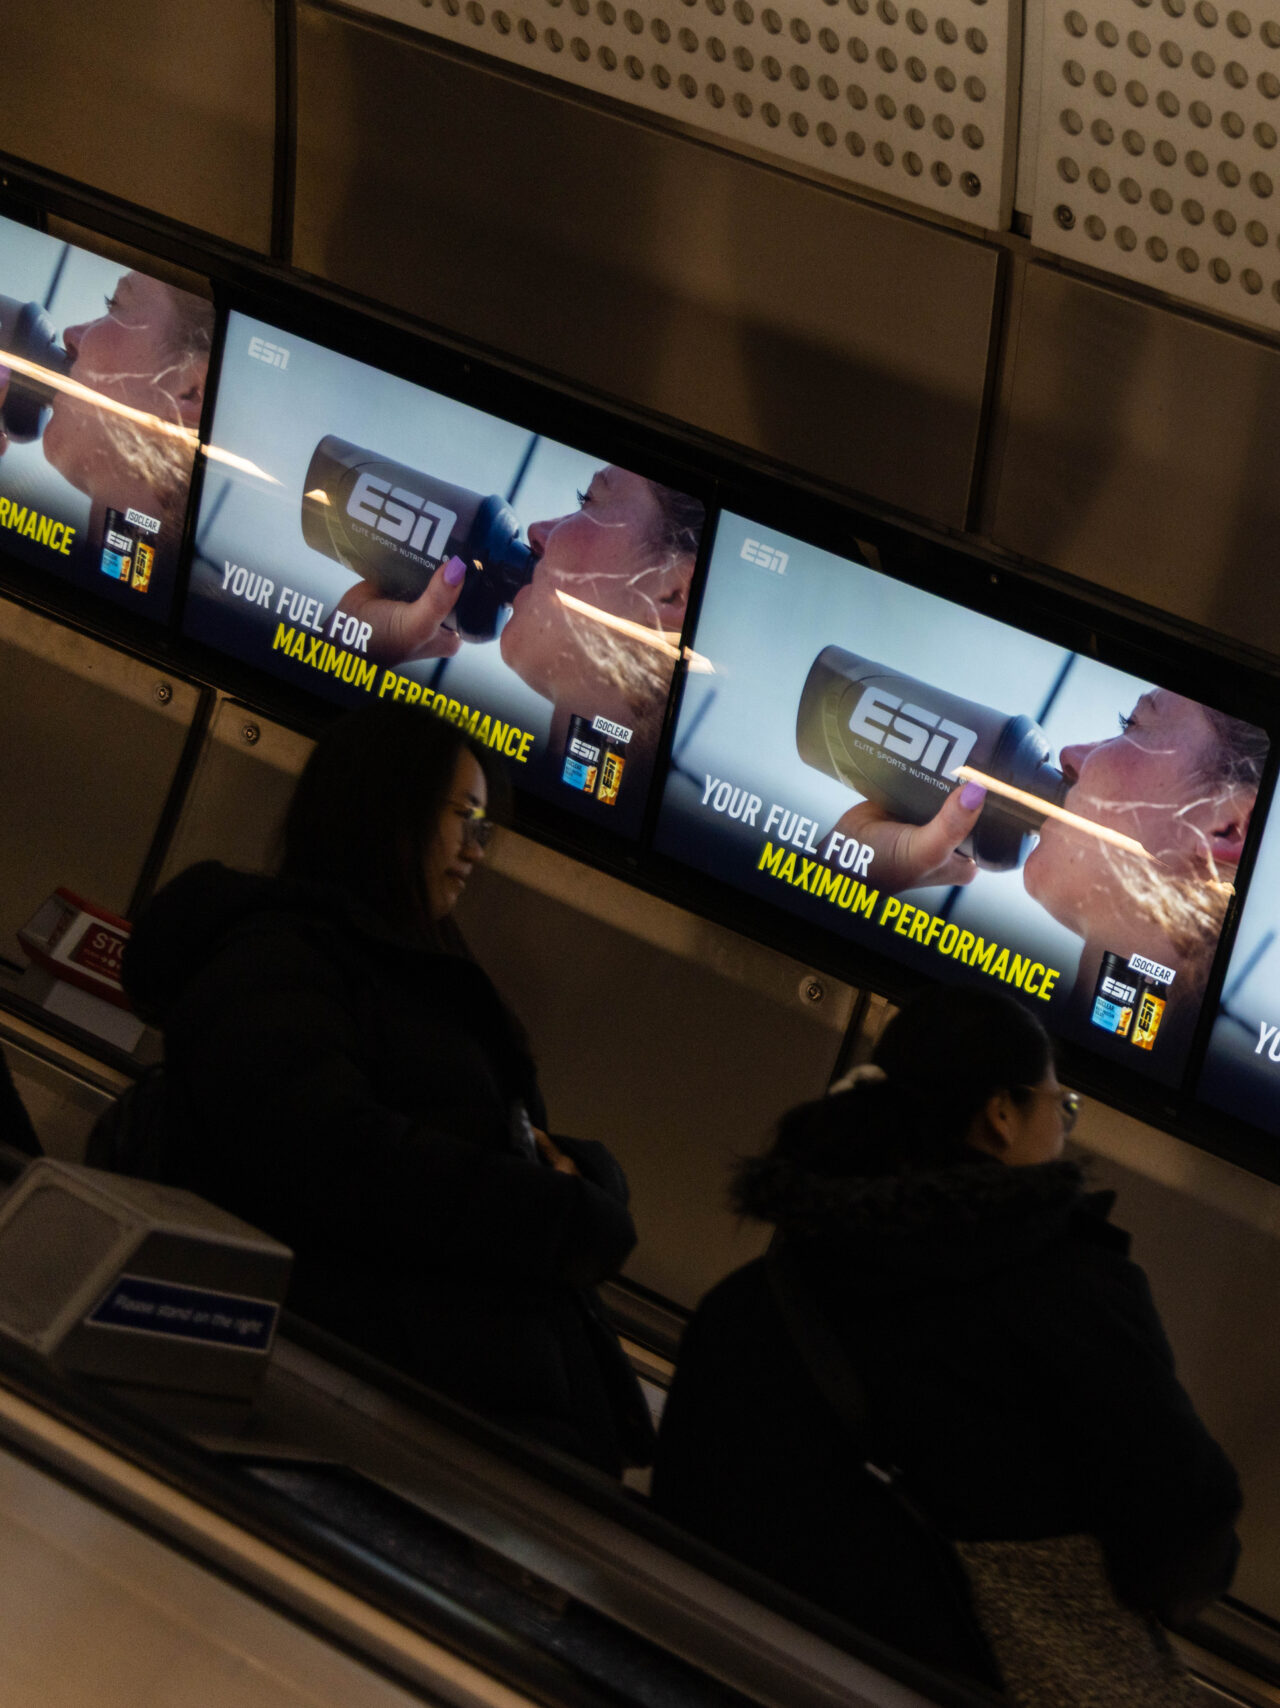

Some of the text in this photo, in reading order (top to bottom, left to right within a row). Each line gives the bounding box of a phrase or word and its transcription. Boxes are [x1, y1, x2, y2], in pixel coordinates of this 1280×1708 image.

[0, 497, 76, 556] RMANCE
[128, 510, 158, 531] ISOCLEAR
[351, 522, 436, 571] ELITE SPORTS NUTRITION
[221, 560, 373, 653] YOUR FUEL FOR
[272, 622, 378, 692] MAXIMUM
[595, 718, 629, 741] ISOCLEAR
[854, 739, 951, 793] ELITE SPORTS NUTRITION
[700, 774, 875, 878] YOUR FUEL FOR
[757, 841, 1061, 1001] MAXIMUM PERFORMANCE
[1131, 957, 1172, 982] ISOCLEAR
[156, 1304, 193, 1321] stand
[211, 1313, 232, 1329] the
